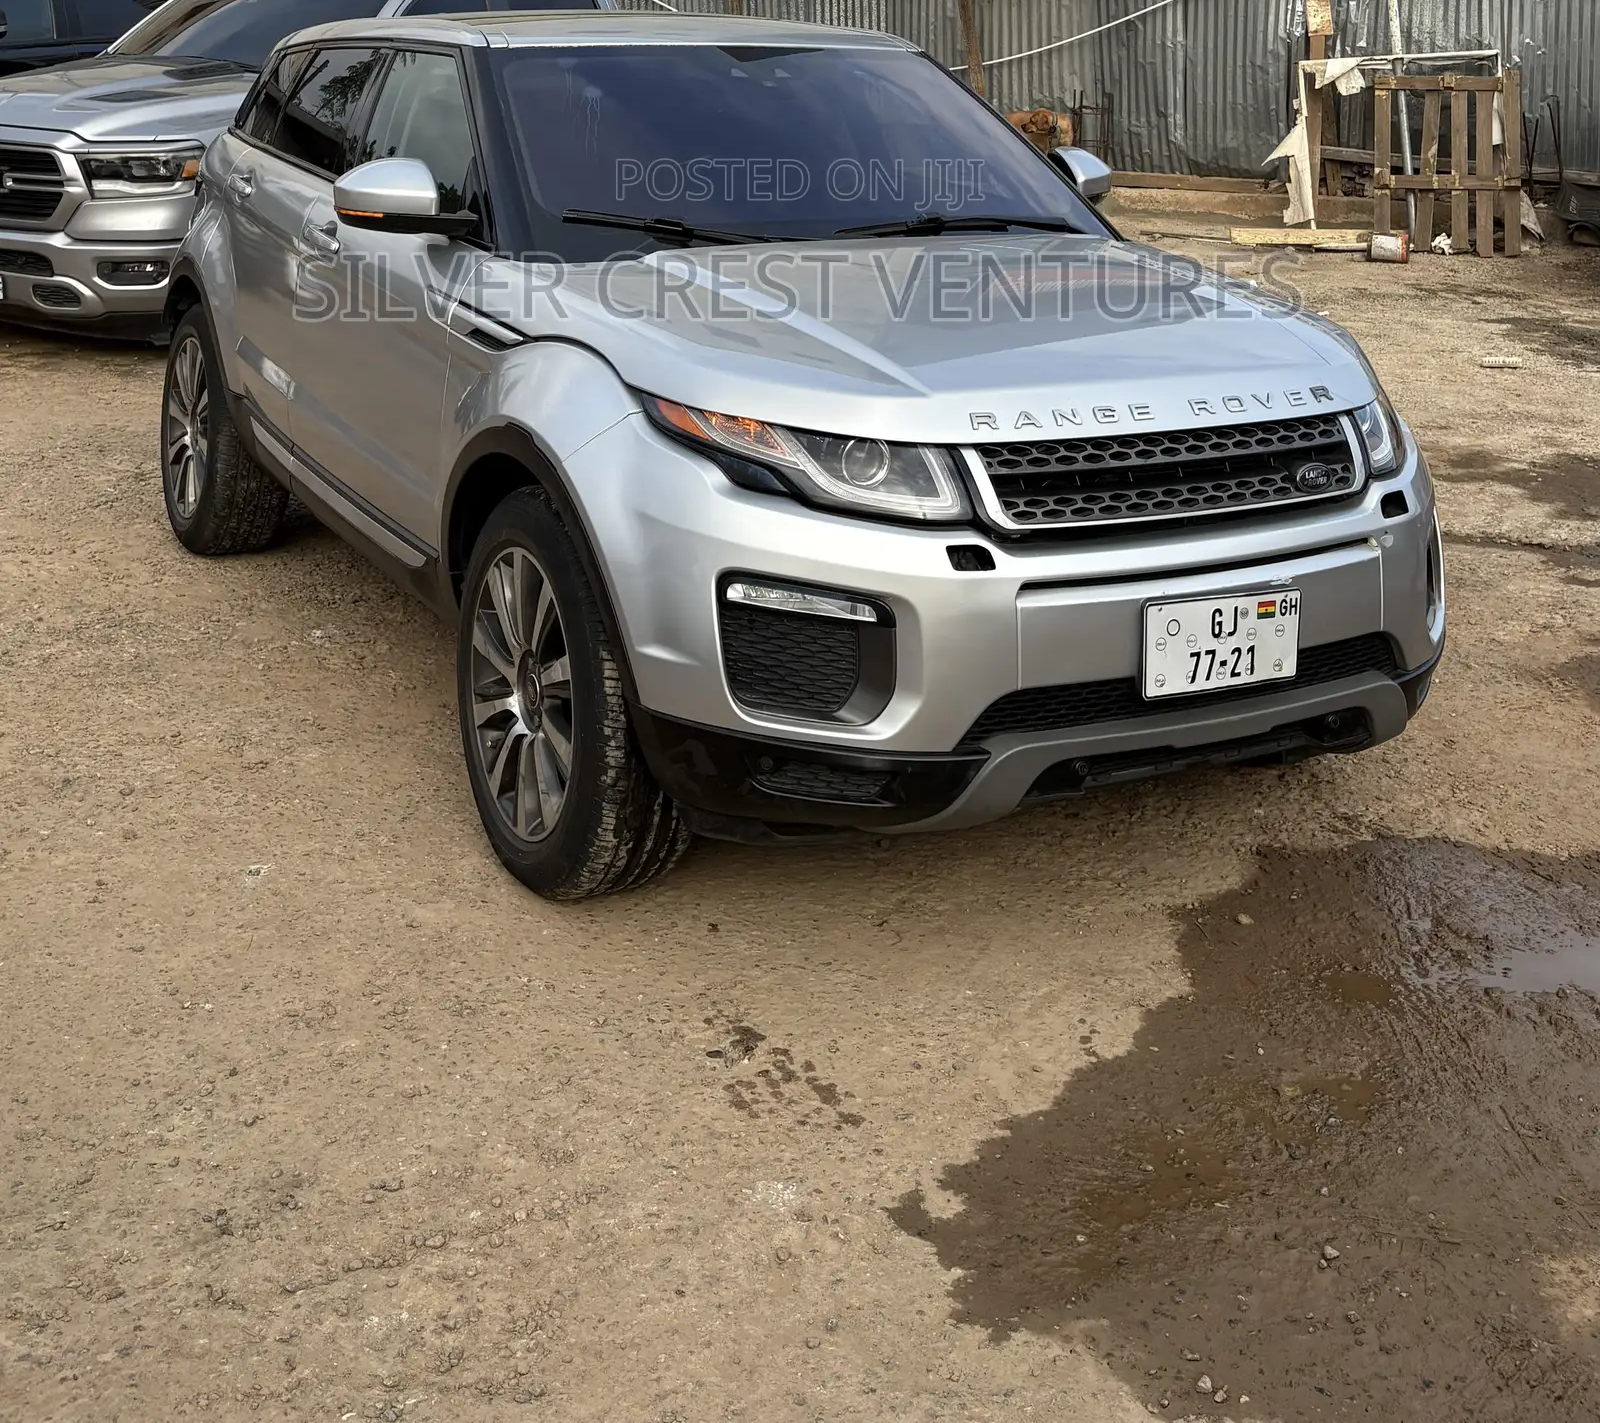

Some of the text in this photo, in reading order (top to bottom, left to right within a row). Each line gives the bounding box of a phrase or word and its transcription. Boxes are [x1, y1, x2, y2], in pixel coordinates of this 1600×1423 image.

[969, 385, 1334, 430] RANGE ROVER
[1211, 597, 1298, 639] GJ GH
[1189, 644, 1256, 684] 77-21
